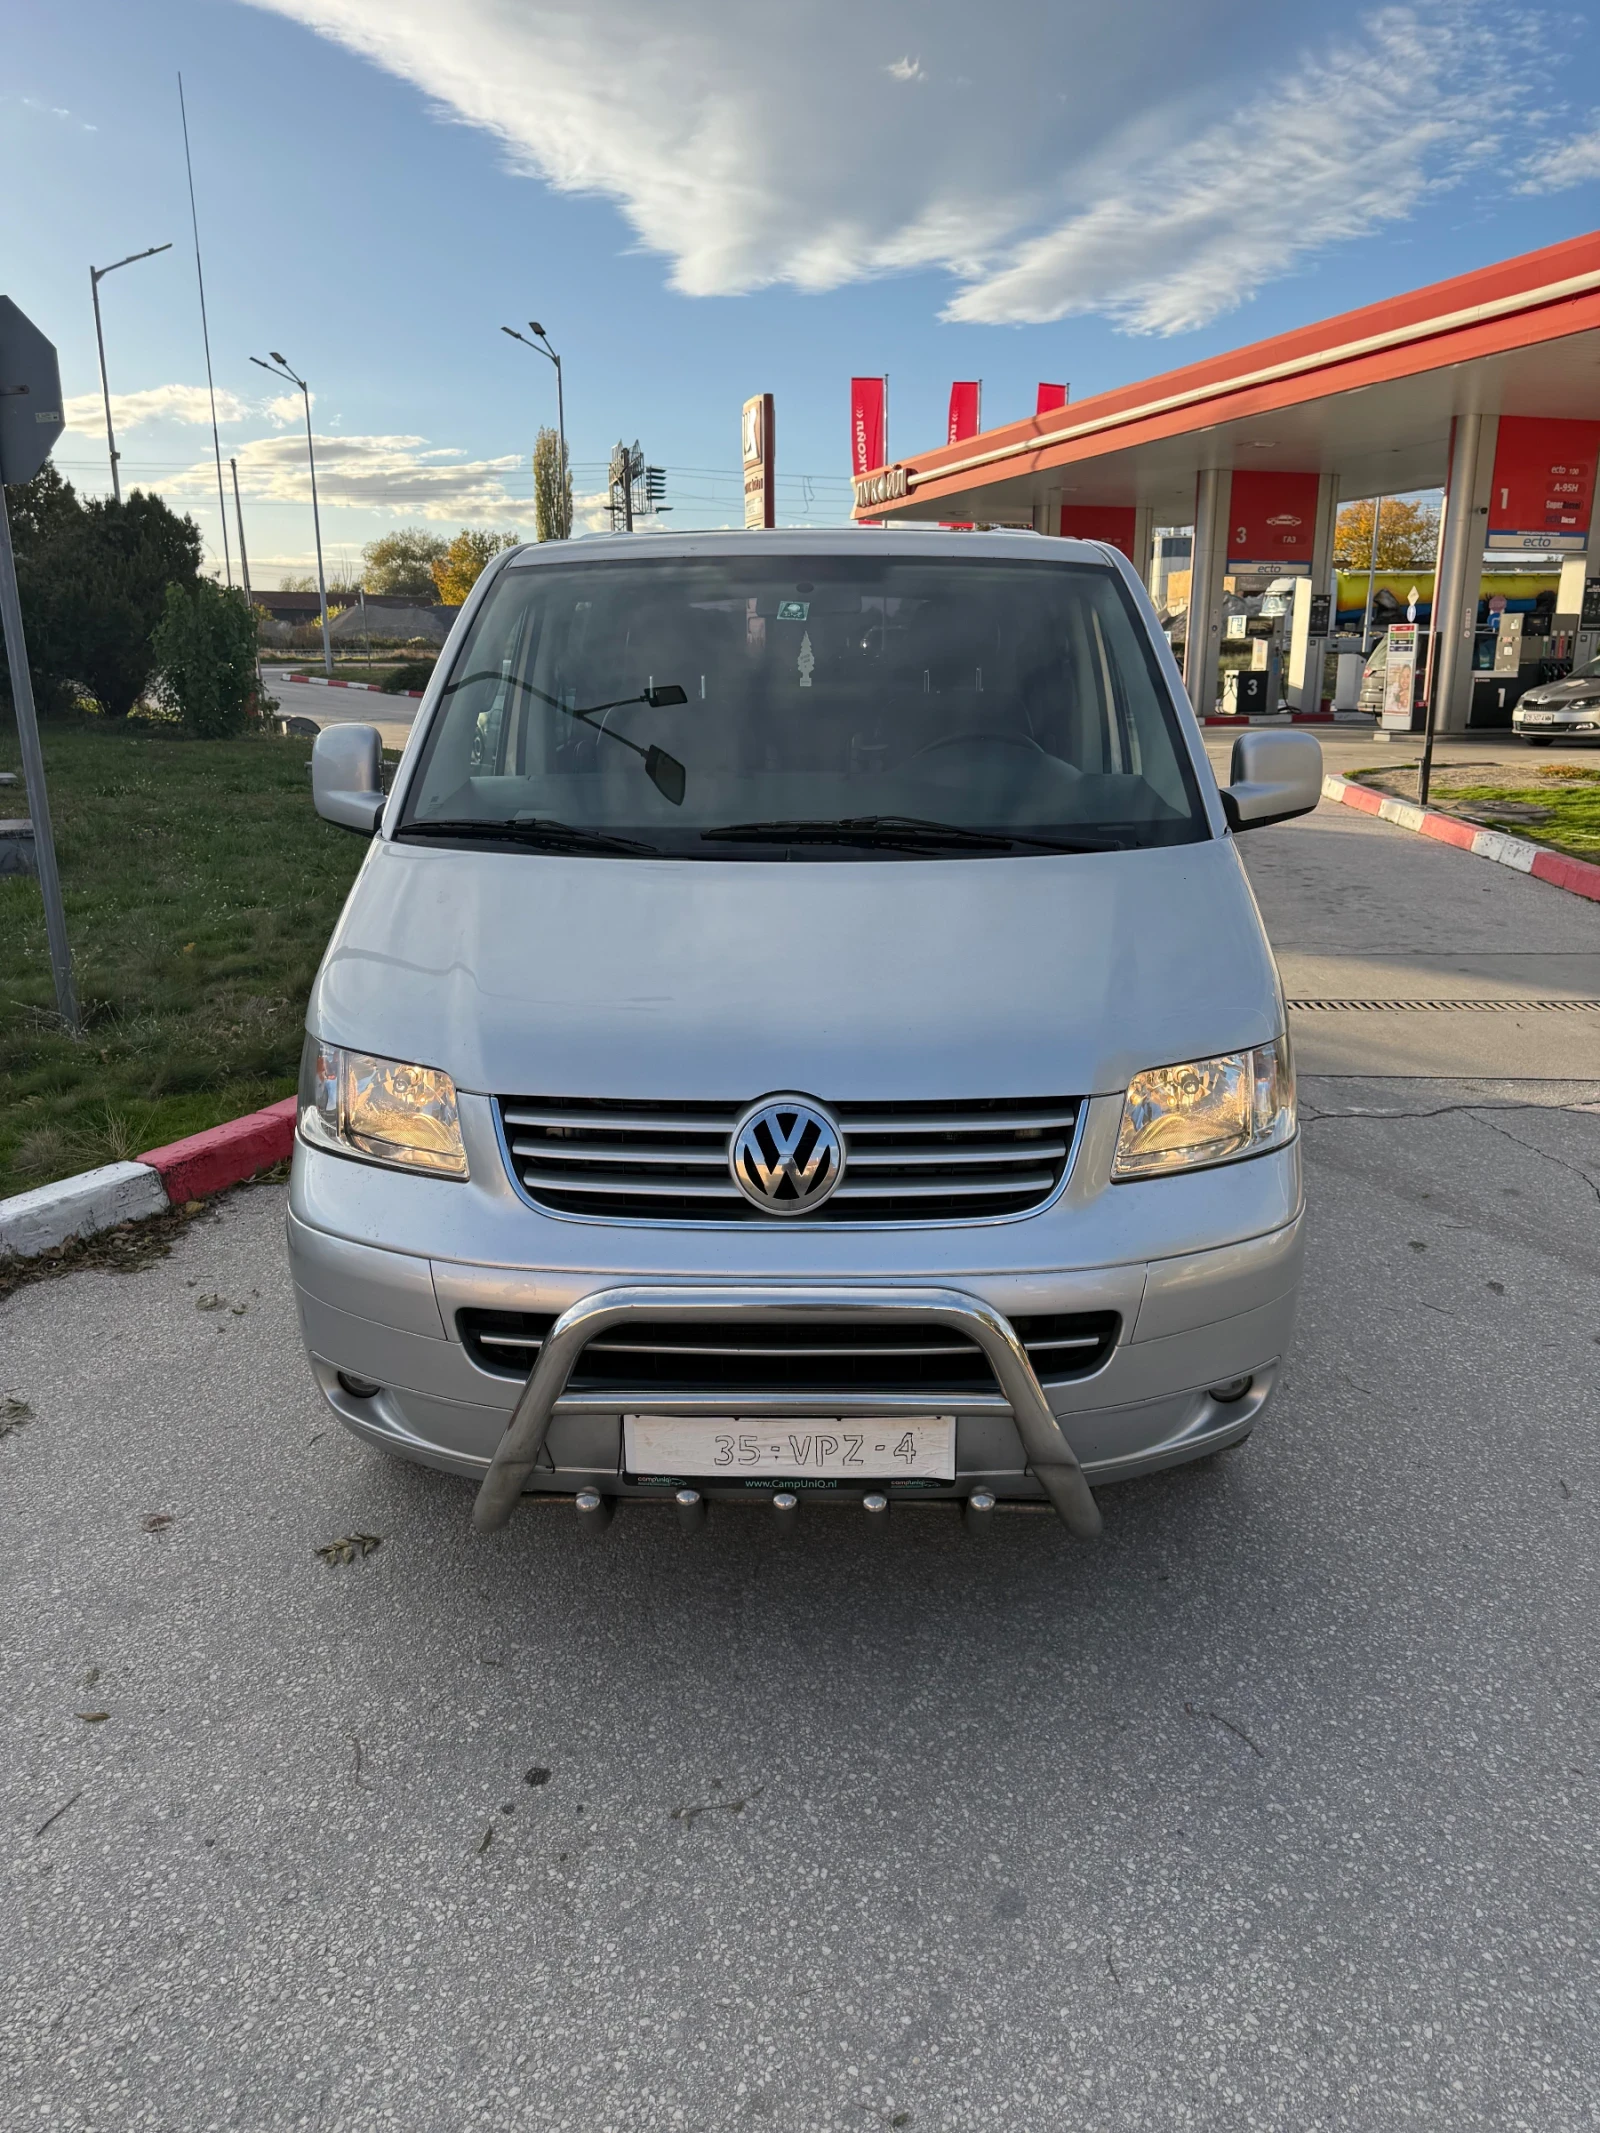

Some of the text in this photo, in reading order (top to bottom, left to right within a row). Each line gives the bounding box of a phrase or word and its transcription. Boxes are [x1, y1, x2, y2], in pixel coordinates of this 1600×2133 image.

[1500, 488, 1509, 509] 1
[1236, 527, 1247, 543] 3
[1523, 537, 1551, 547] ecto
[1258, 564, 1281, 573] ecto
[1247, 679, 1258, 695] 3
[1498, 688, 1506, 707] 1
